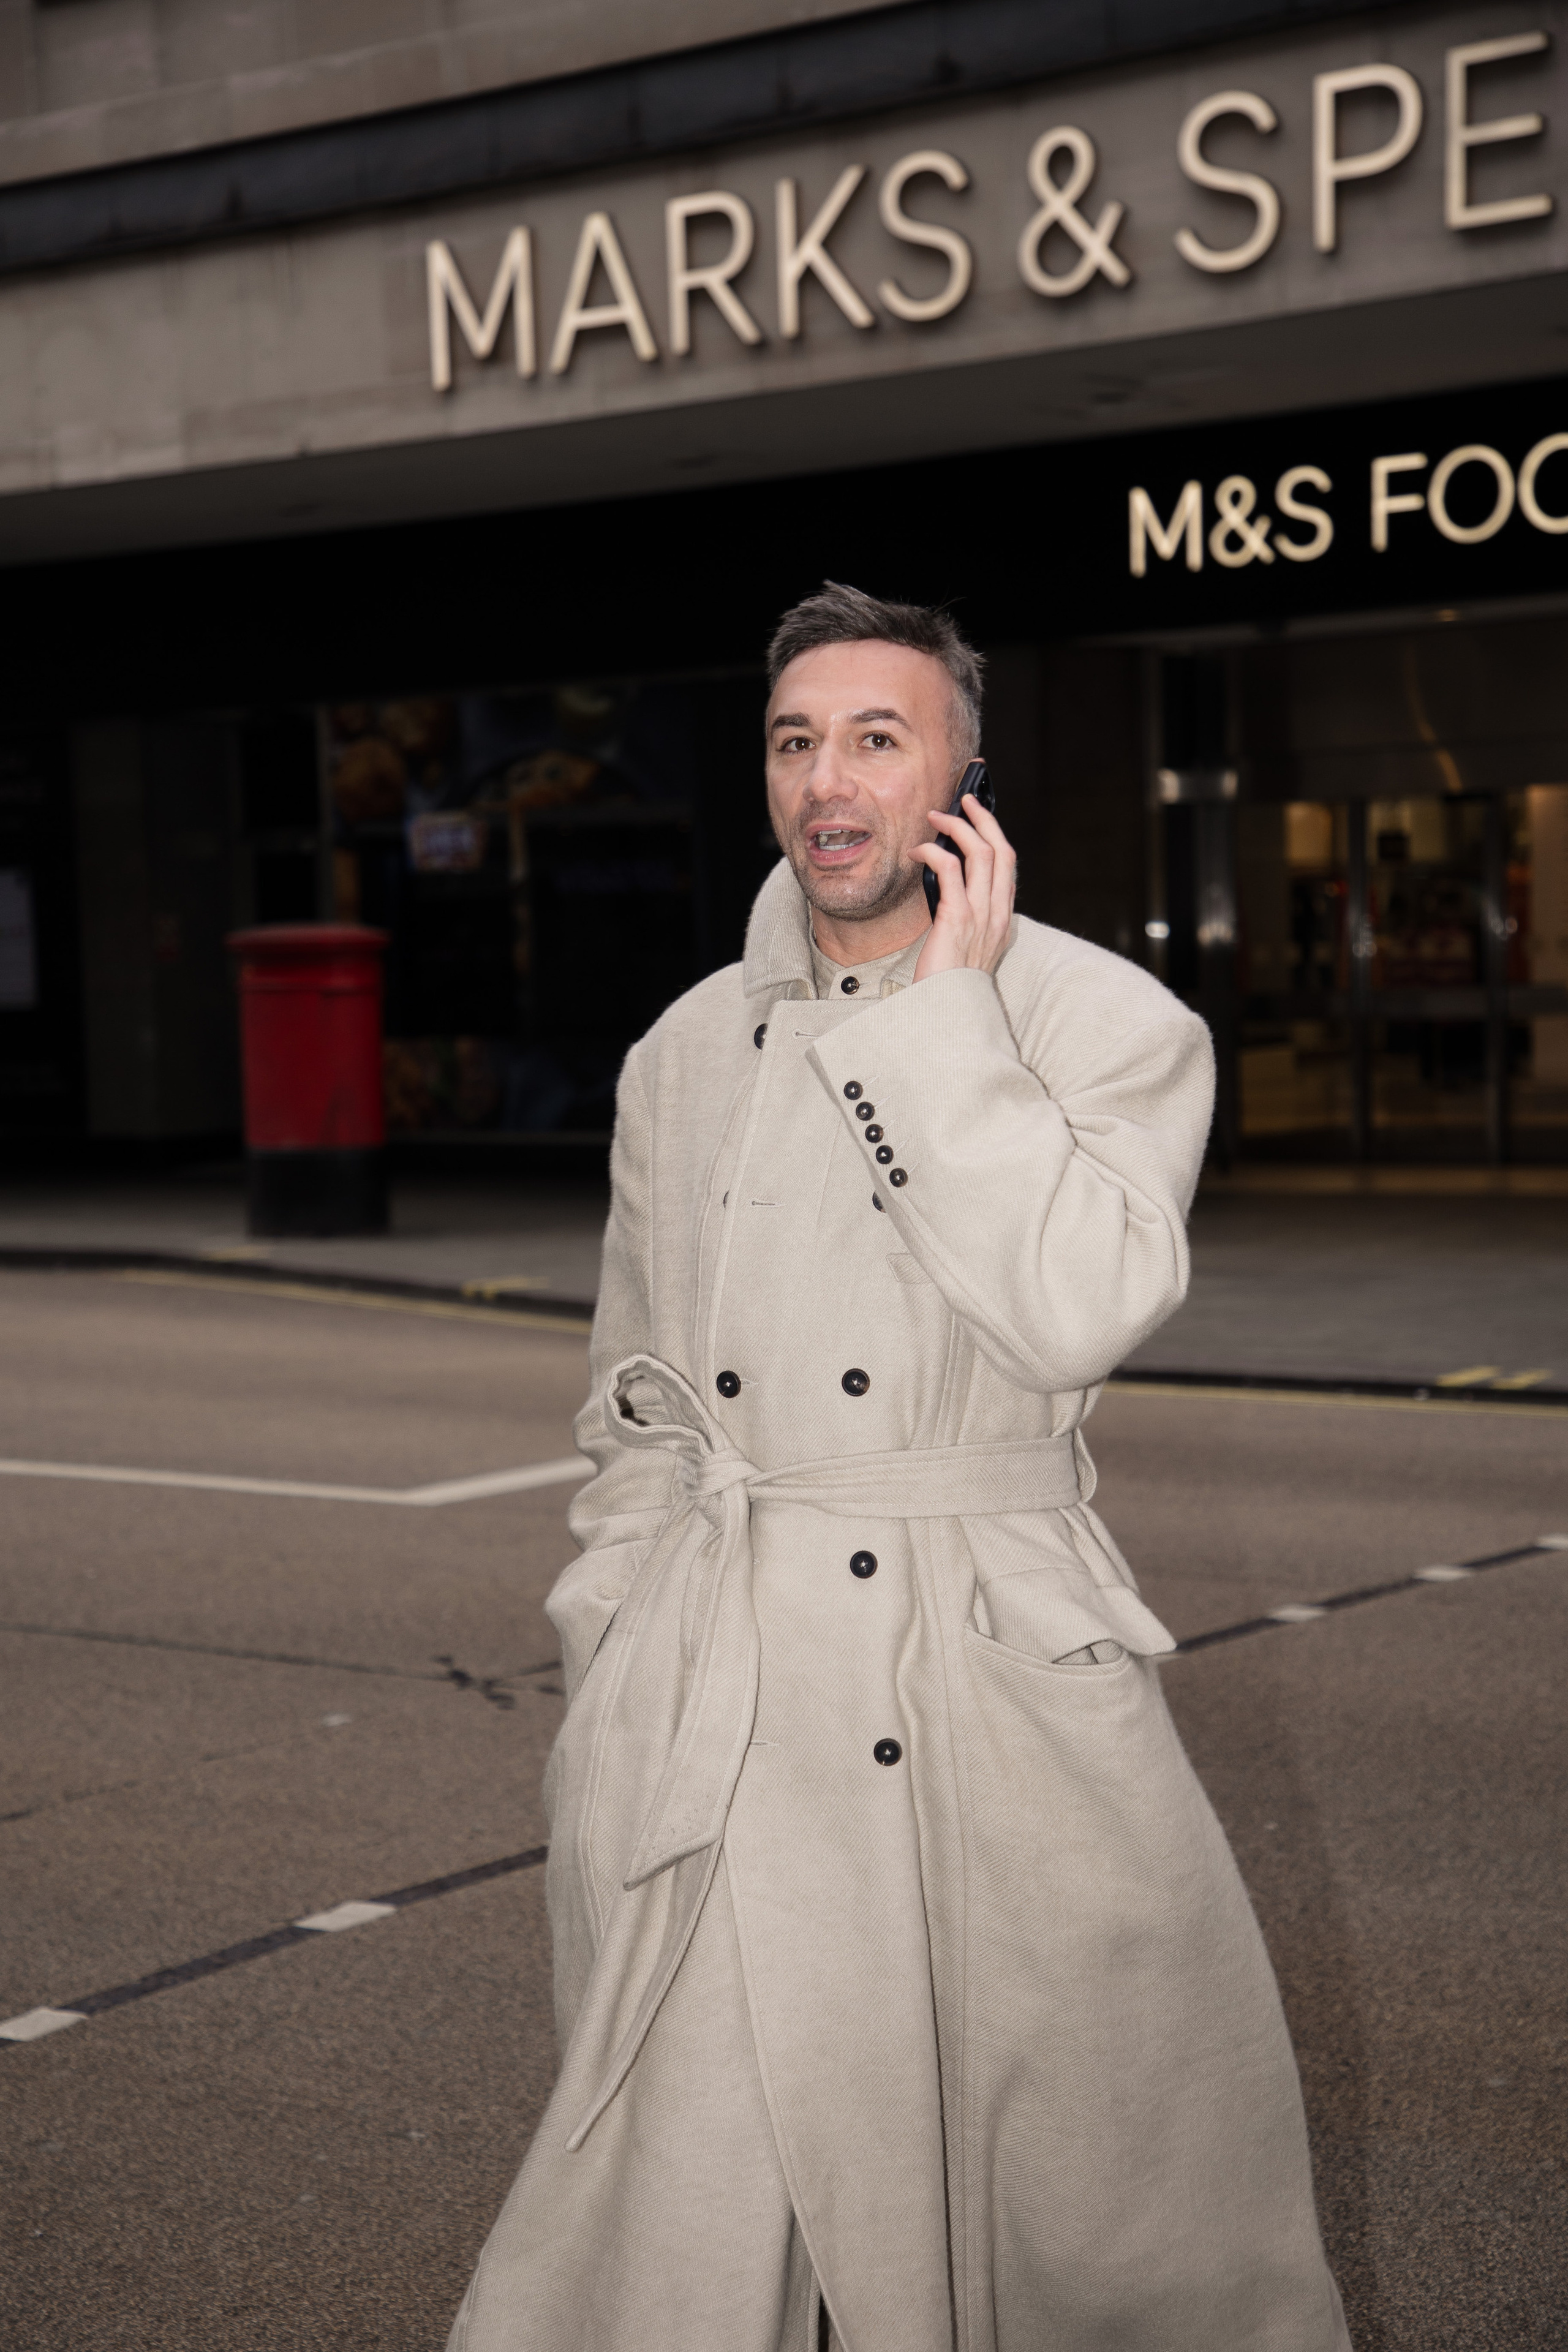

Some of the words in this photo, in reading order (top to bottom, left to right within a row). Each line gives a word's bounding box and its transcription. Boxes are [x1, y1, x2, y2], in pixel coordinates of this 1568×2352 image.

[426, 151, 973, 390] MARKS
[1019, 125, 1131, 297] &
[1176, 31, 1553, 271] SPE
[1128, 464, 1335, 578] M&S
